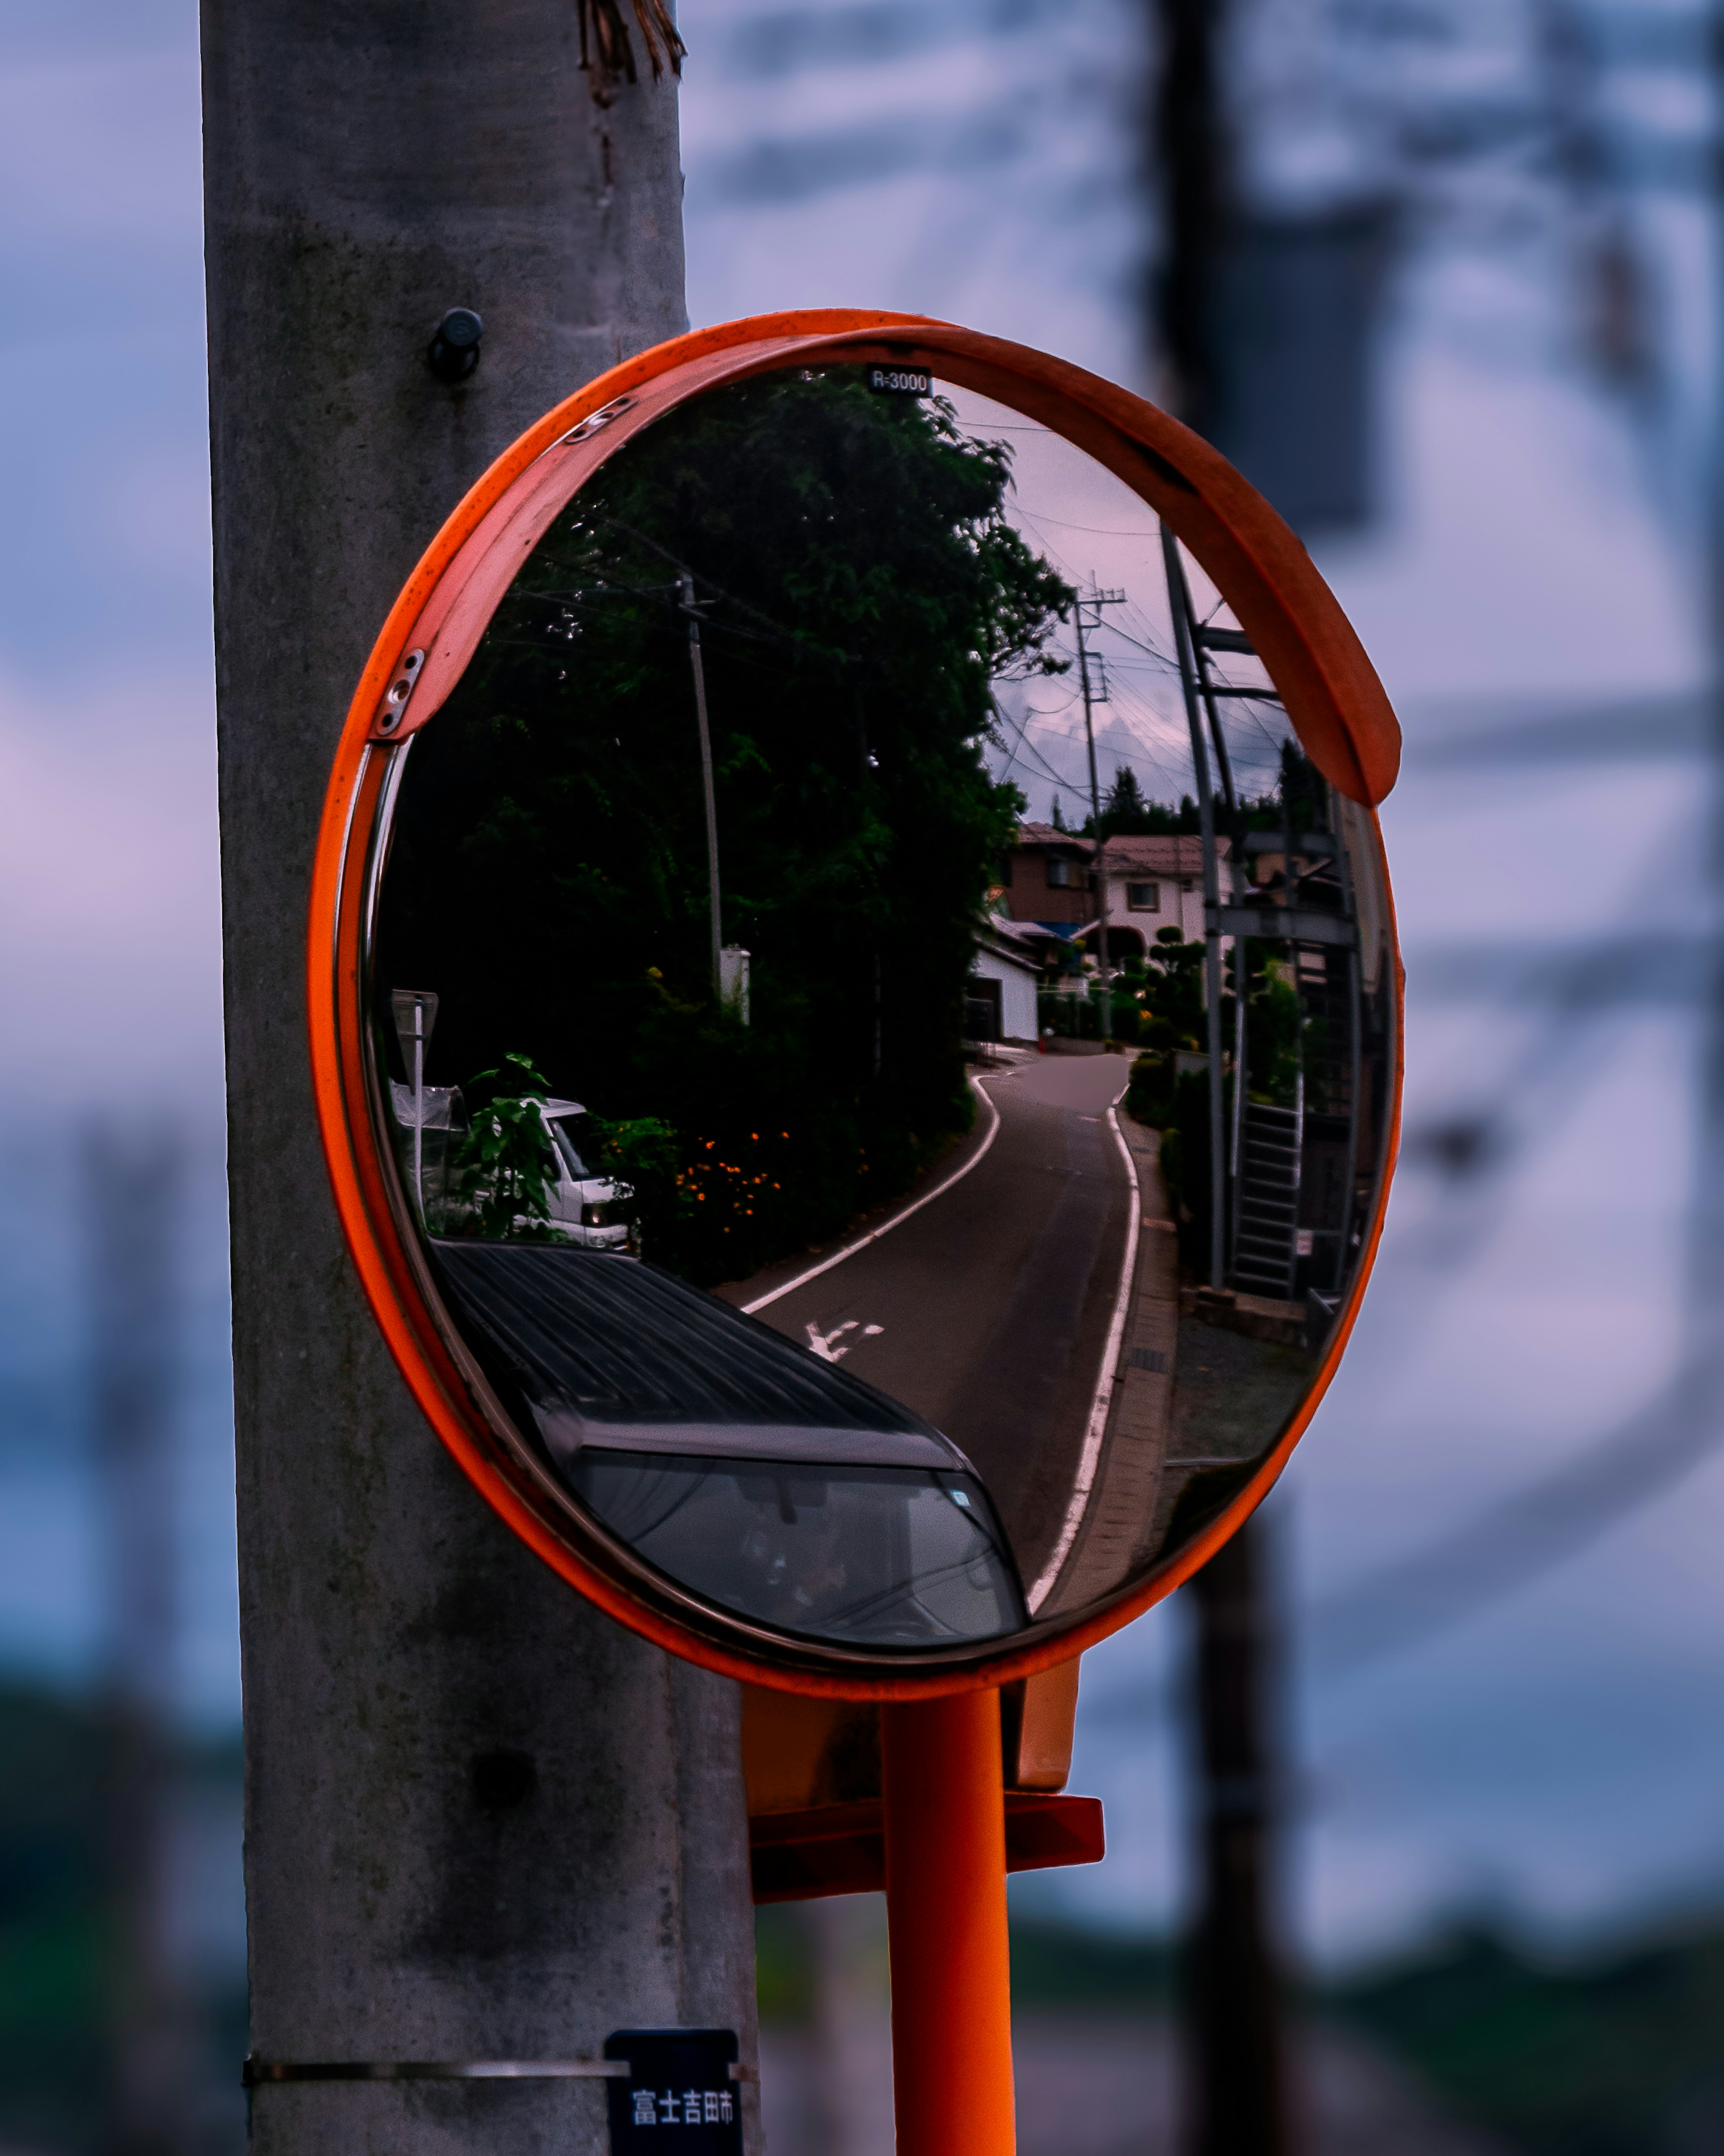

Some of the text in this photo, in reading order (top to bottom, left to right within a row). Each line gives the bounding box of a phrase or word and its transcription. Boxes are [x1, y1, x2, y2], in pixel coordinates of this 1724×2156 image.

[633, 2089, 733, 2125] 富士吉田市
